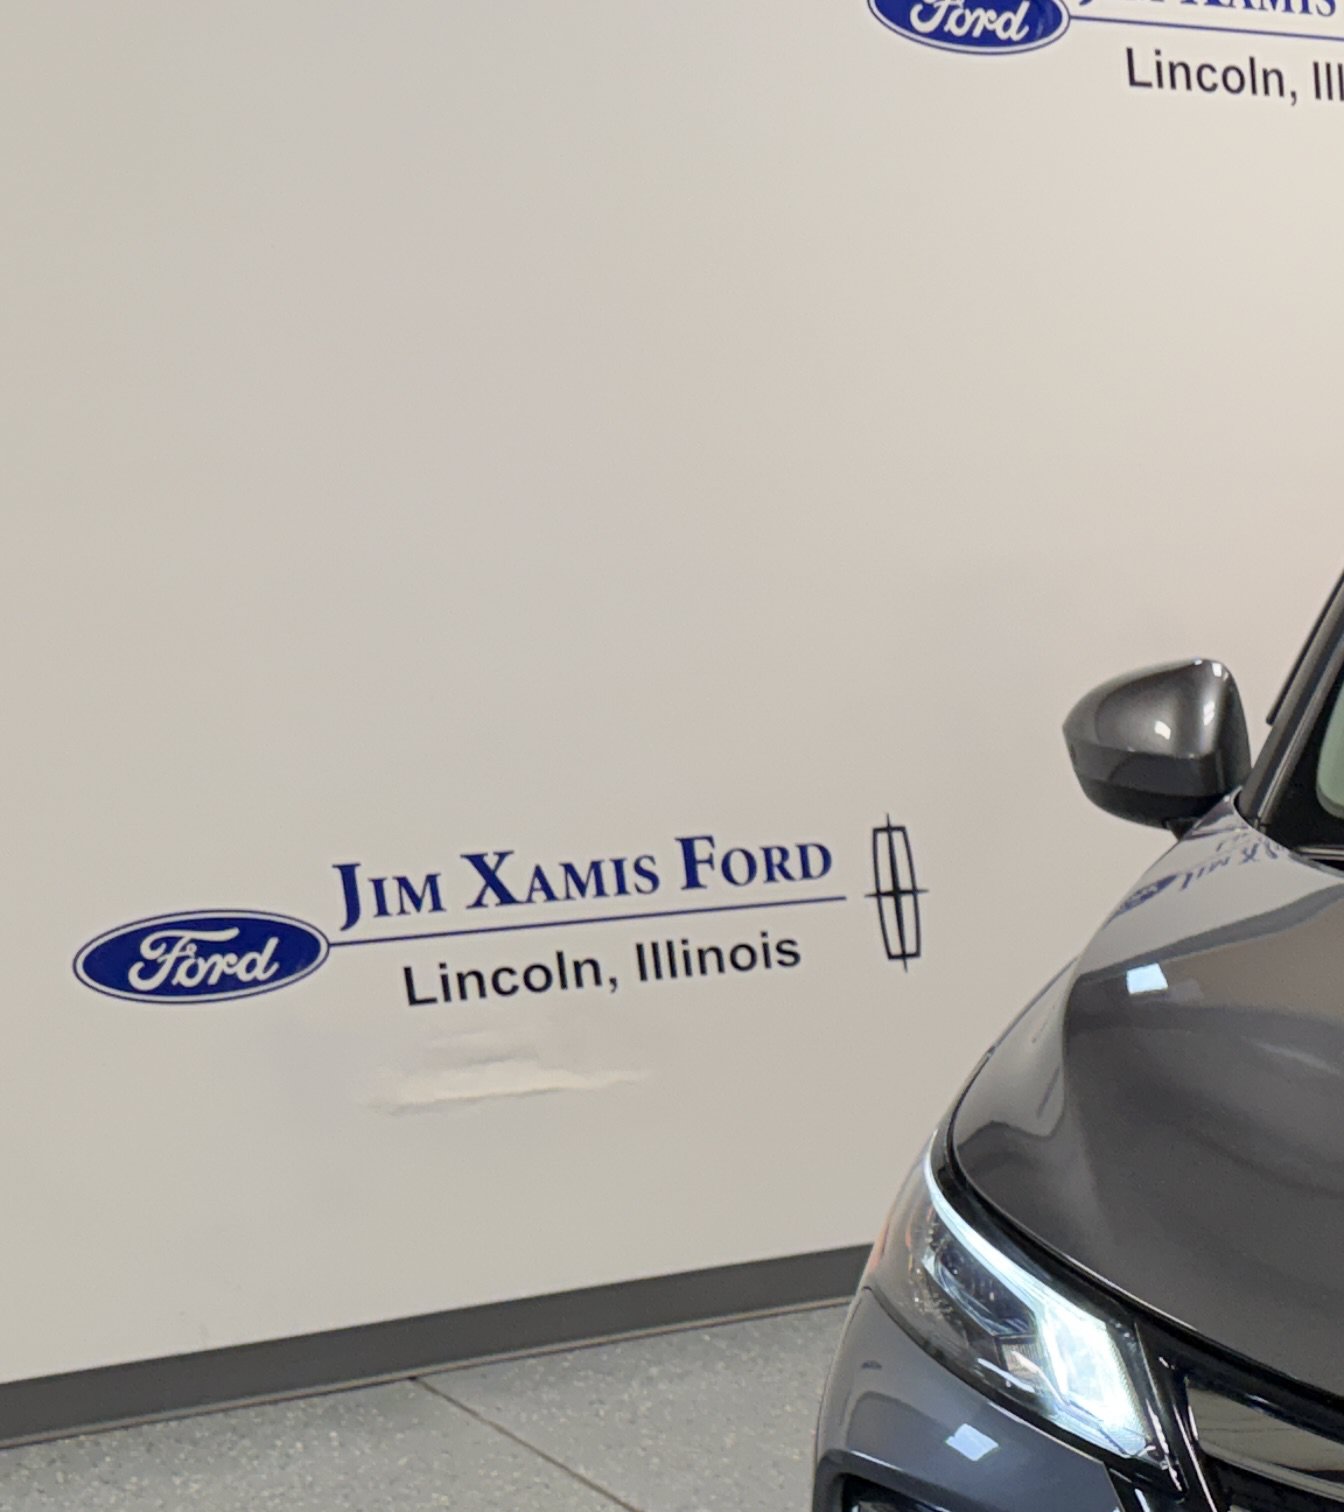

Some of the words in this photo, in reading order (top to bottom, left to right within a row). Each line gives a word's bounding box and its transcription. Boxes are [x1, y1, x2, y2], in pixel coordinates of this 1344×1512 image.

[1126, 46, 1298, 106] Lincoln,
[332, 862, 443, 932] JIM
[460, 850, 660, 911] XAMIS
[675, 835, 832, 891] FORD
[127, 929, 279, 992] Ford
[403, 950, 618, 1007] Lincoln,
[635, 931, 801, 982] Illinois
